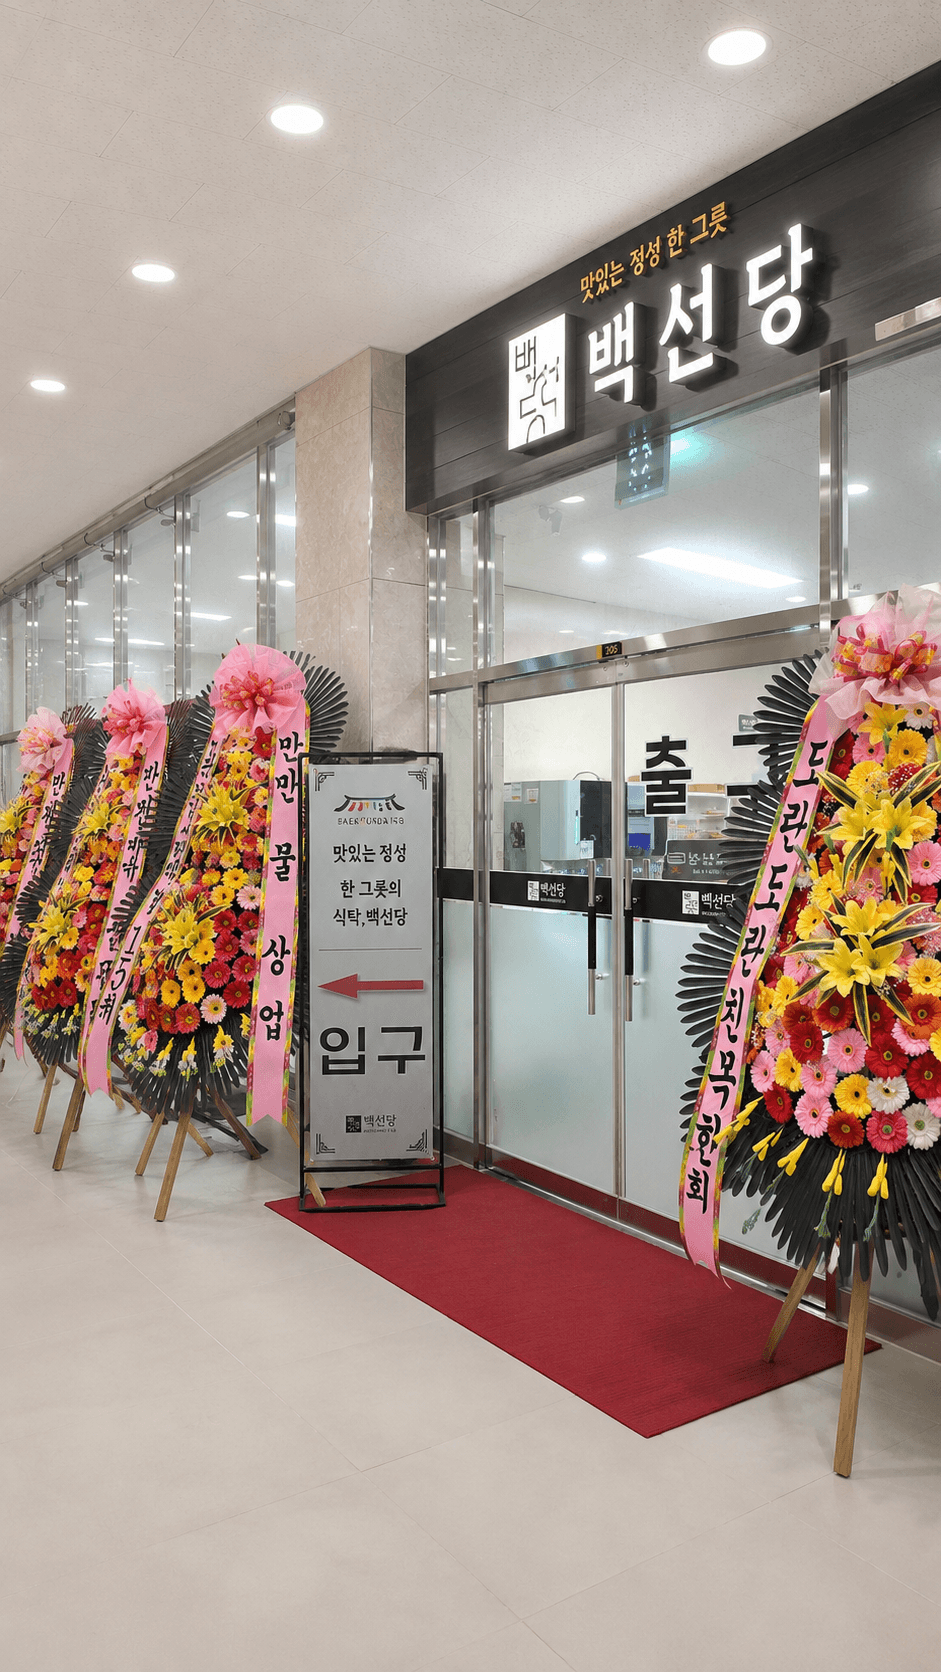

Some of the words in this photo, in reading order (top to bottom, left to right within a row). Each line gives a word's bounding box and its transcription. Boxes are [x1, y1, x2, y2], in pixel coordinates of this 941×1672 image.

[580, 260, 624, 303] 맛있는
[629, 236, 662, 275] 정성
[666, 224, 687, 257] 한
[690, 201, 727, 244] 그릇
[588, 223, 813, 403] 백선당
[333, 843, 376, 863] 맛있는
[379, 843, 406, 863] 정성
[340, 879, 355, 898] 한
[319, 1026, 426, 1076] 입구
[363, 1114, 397, 1127] 백선당
